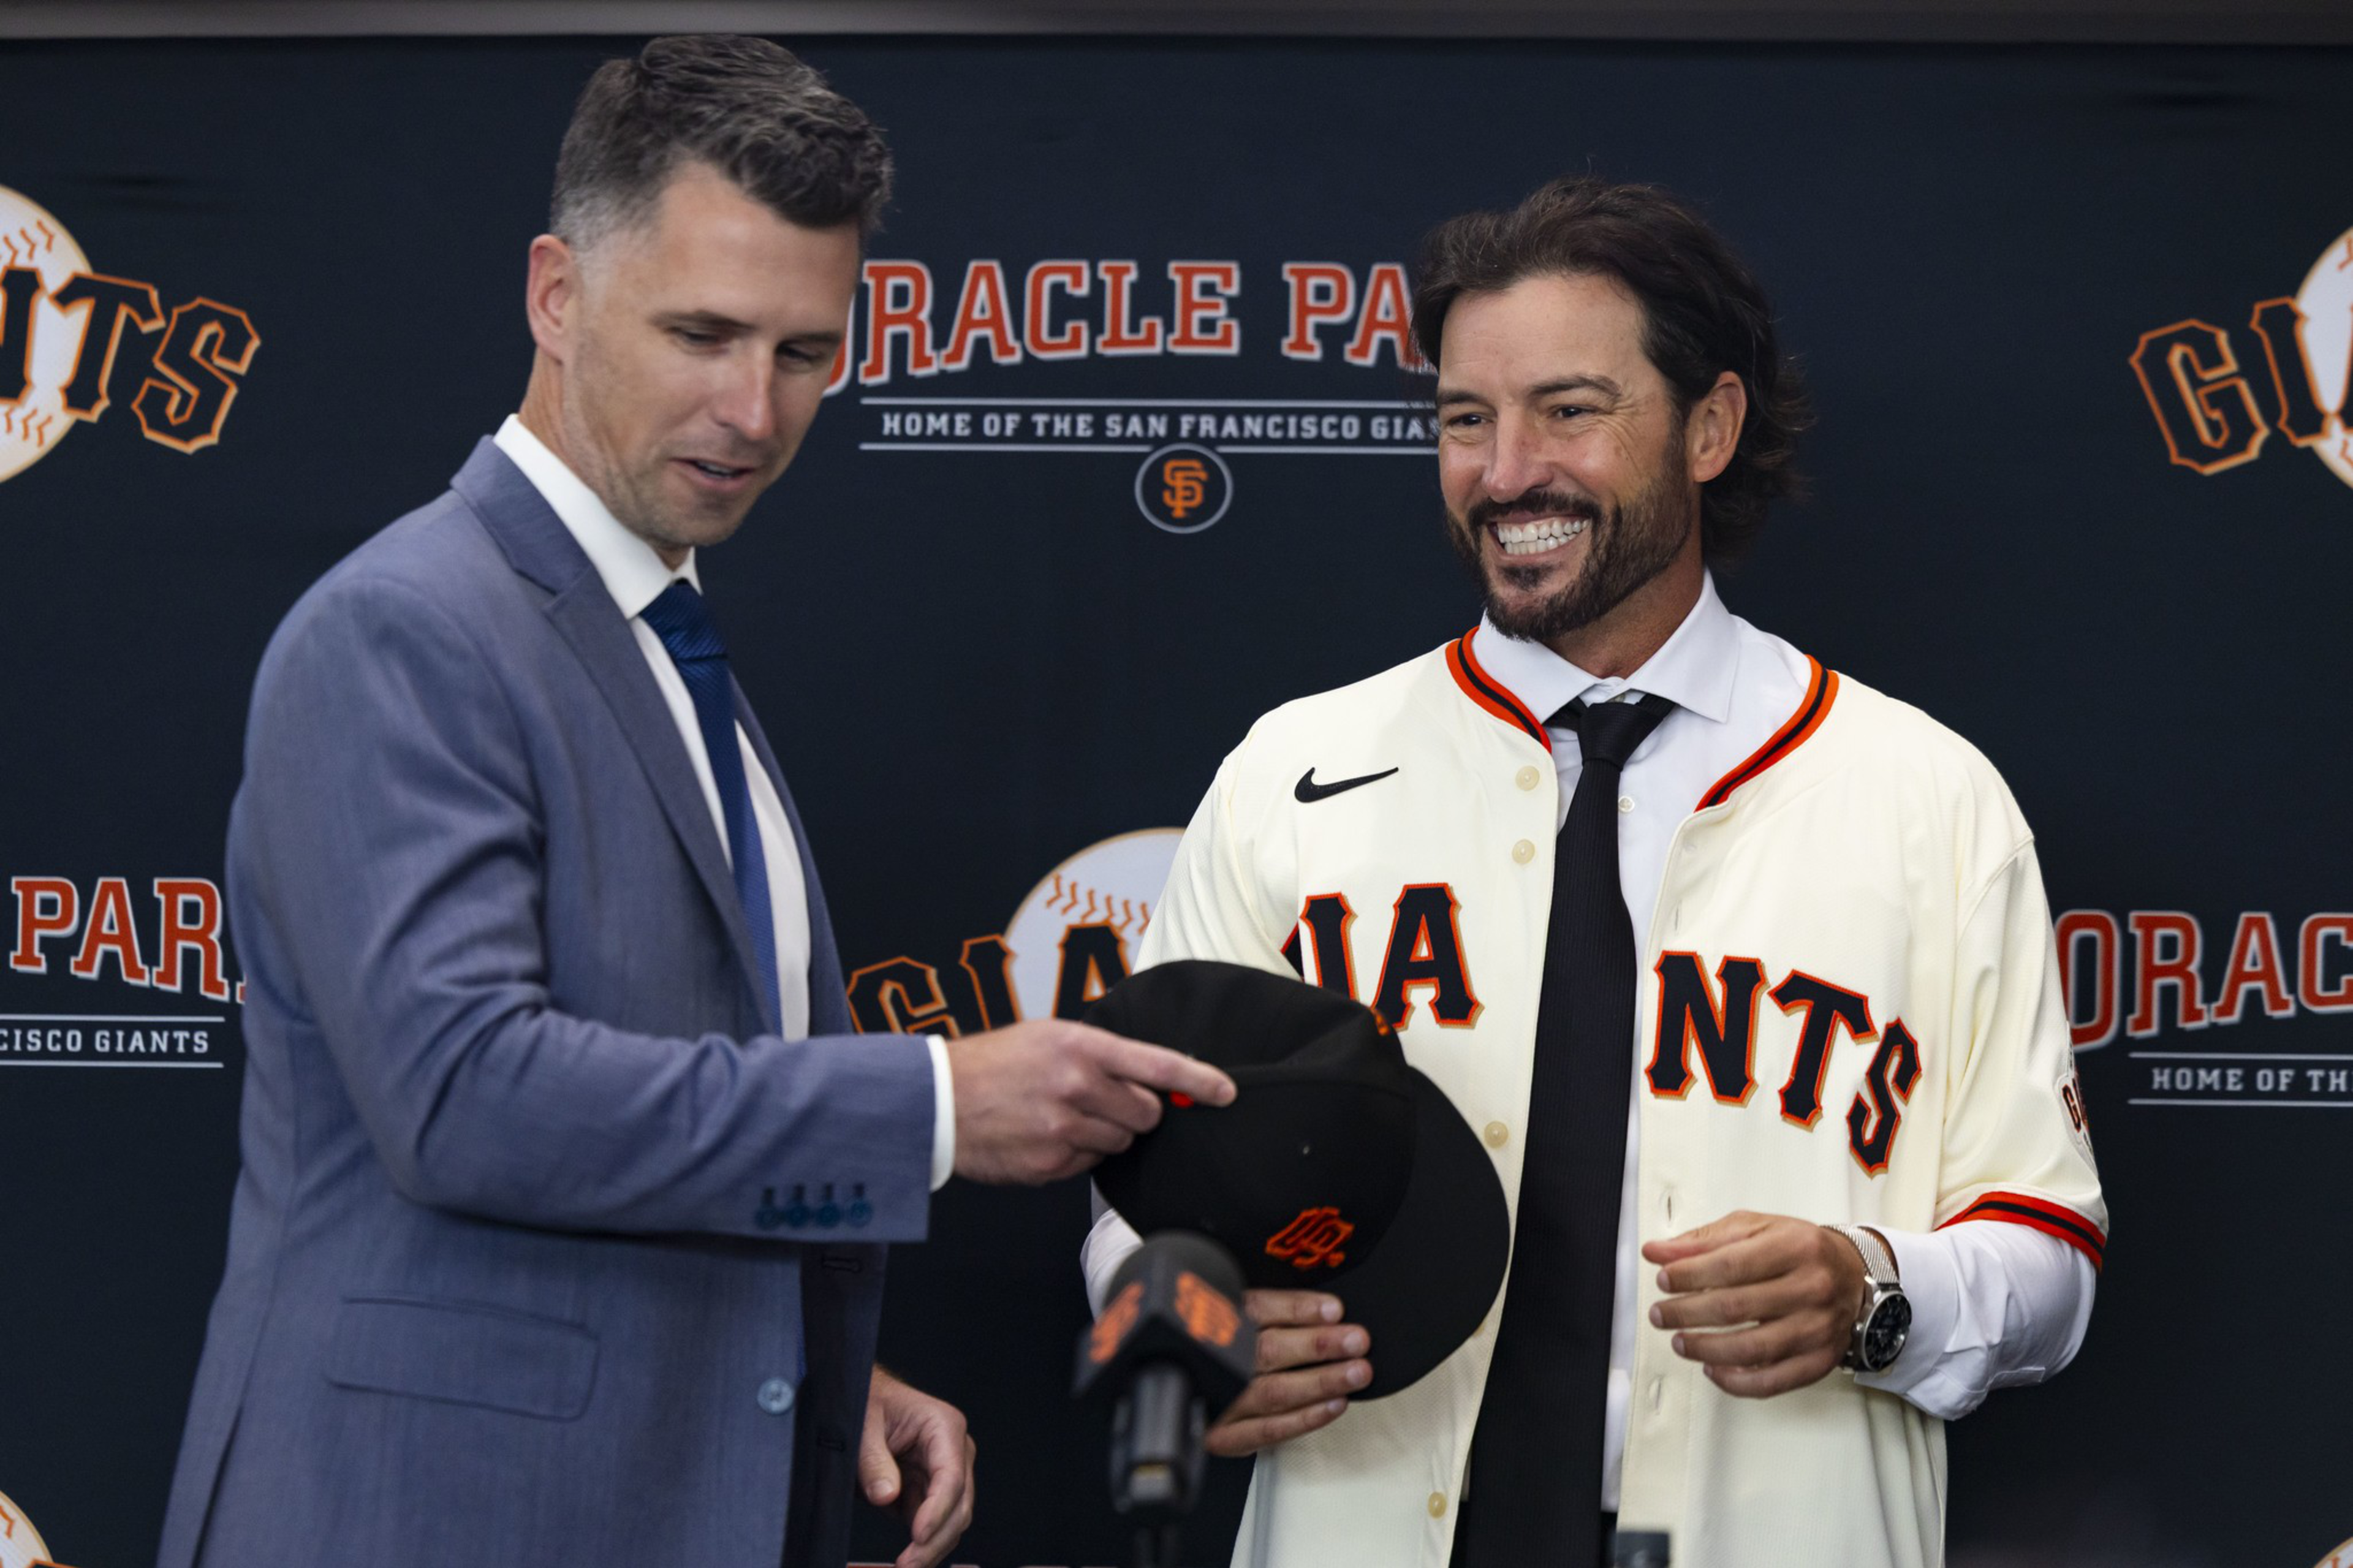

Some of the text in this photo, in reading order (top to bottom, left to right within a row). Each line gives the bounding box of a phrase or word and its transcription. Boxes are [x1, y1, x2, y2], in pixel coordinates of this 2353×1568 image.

[822, 259, 1438, 397] RACLE PA
[882, 412, 972, 437] HOME
[983, 412, 1021, 437] OF
[1031, 413, 1094, 437] THE
[1105, 414, 1168, 438] SAN
[1178, 414, 1361, 439] FRANCISCO
[10, 876, 246, 1004] PAR
[94, 1029, 210, 1054] GIANTS
[1281, 882, 1922, 1179] IANTS
[2151, 1066, 2353, 1093] HOME OF TH
